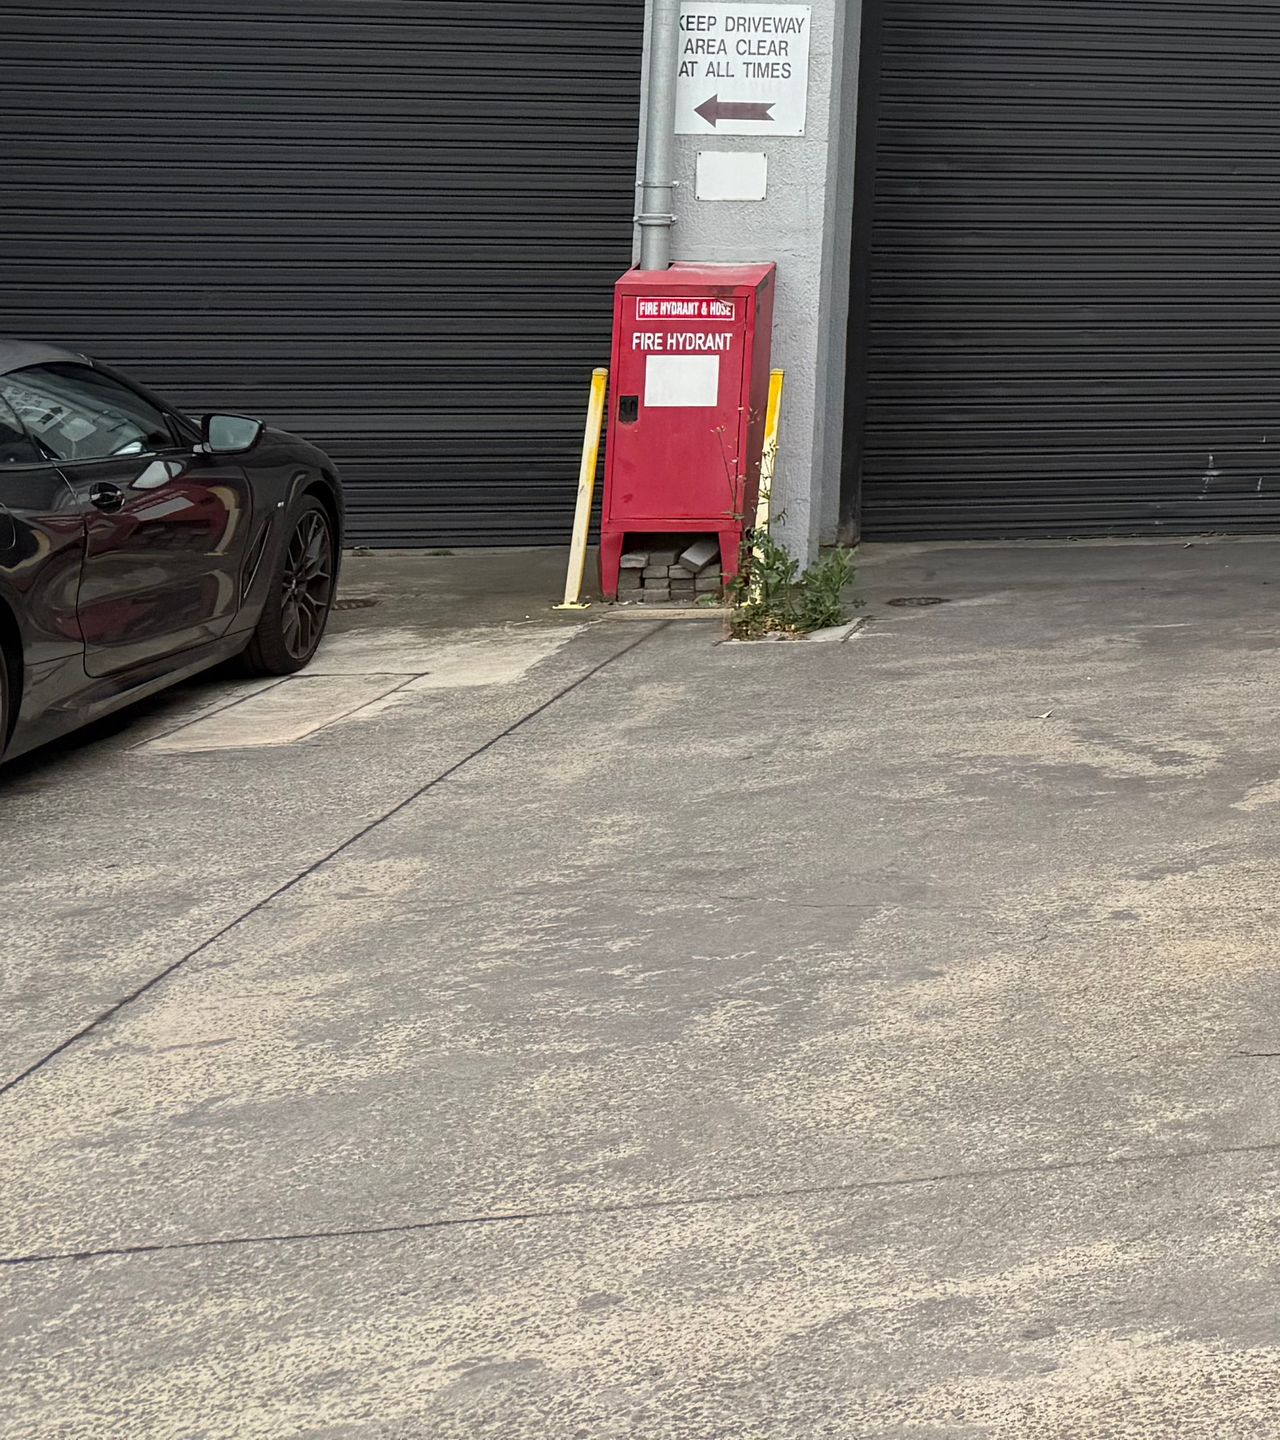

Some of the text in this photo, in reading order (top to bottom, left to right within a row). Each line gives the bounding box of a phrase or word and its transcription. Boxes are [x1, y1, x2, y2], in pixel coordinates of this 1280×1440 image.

[724, 15, 806, 34] DRIVEWAY
[683, 37, 790, 57] AREA CLEAR
[678, 60, 792, 80] AT ALL TIMES
[639, 301, 732, 316] FIRE HYDRANT & HOSE
[632, 332, 733, 351] FIRE HYDRANT
